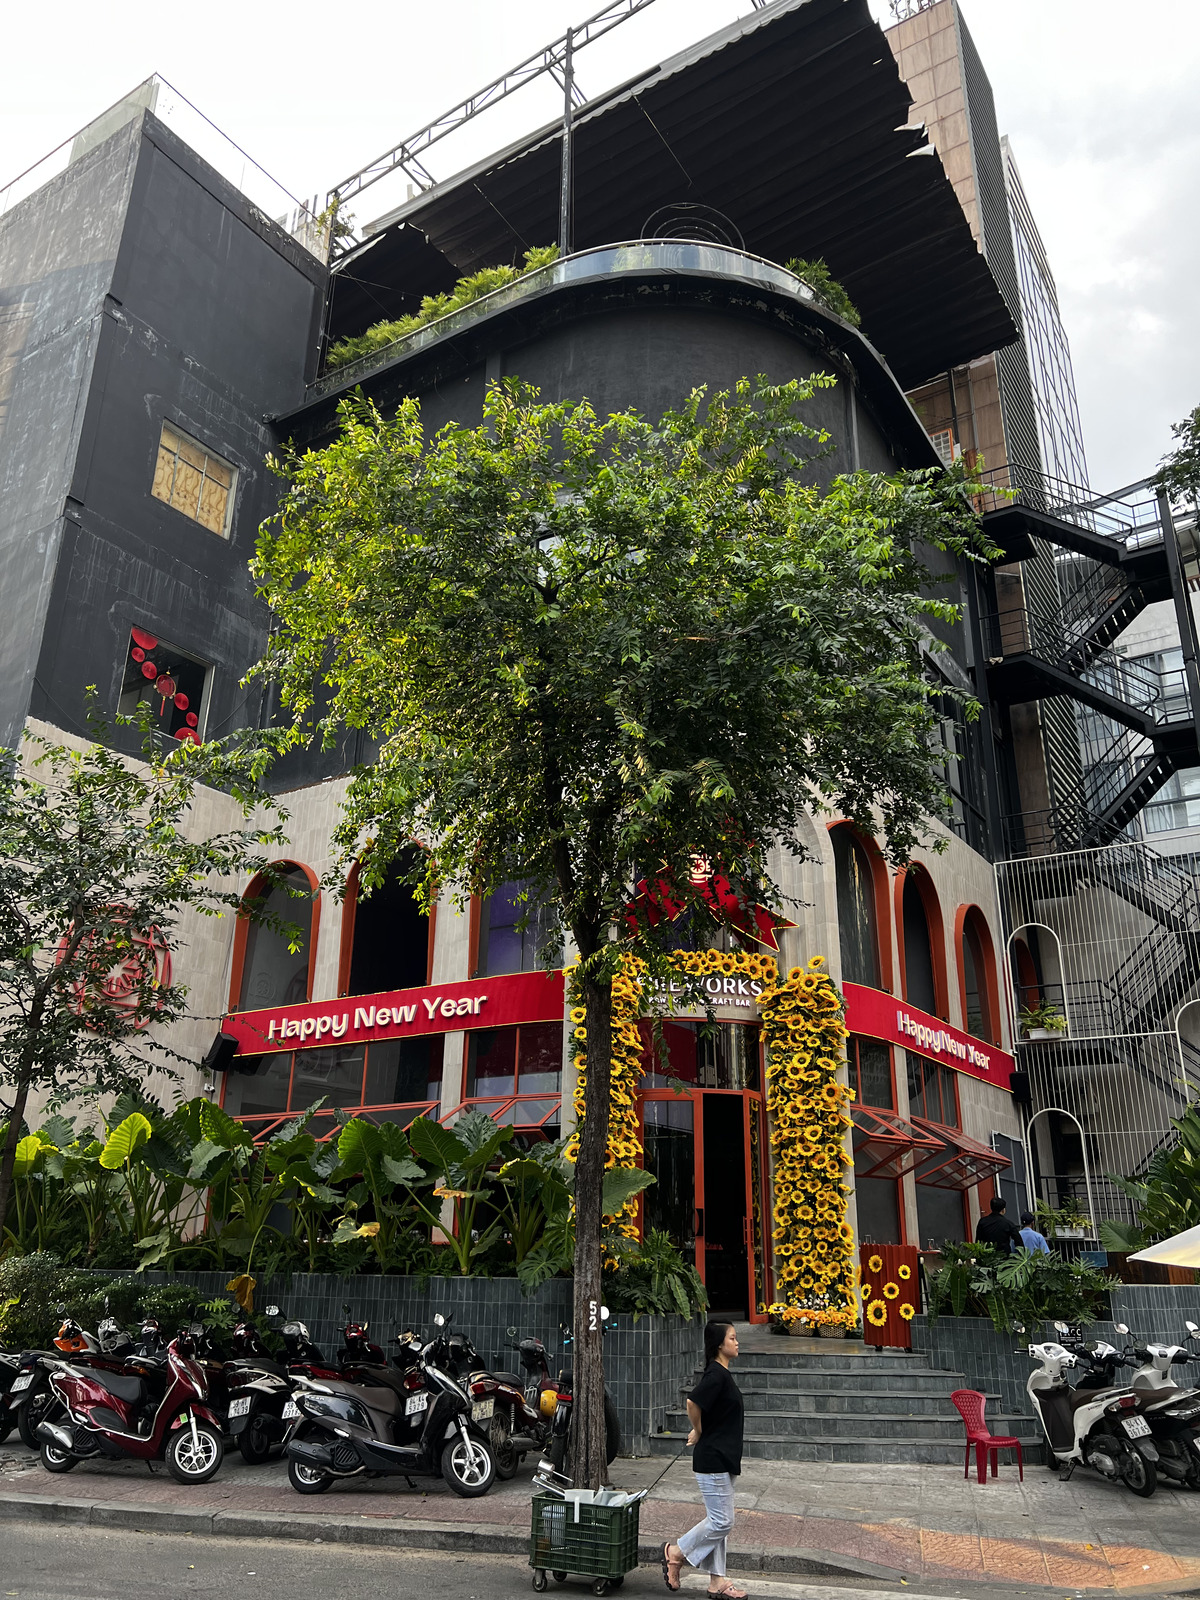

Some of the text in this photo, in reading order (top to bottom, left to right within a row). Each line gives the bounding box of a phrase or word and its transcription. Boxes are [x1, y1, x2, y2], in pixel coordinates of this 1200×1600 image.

[268, 995, 488, 1041] Happy New Year
[735, 998, 751, 1007] BAR
[896, 1010, 991, 1070] Happy New Year
